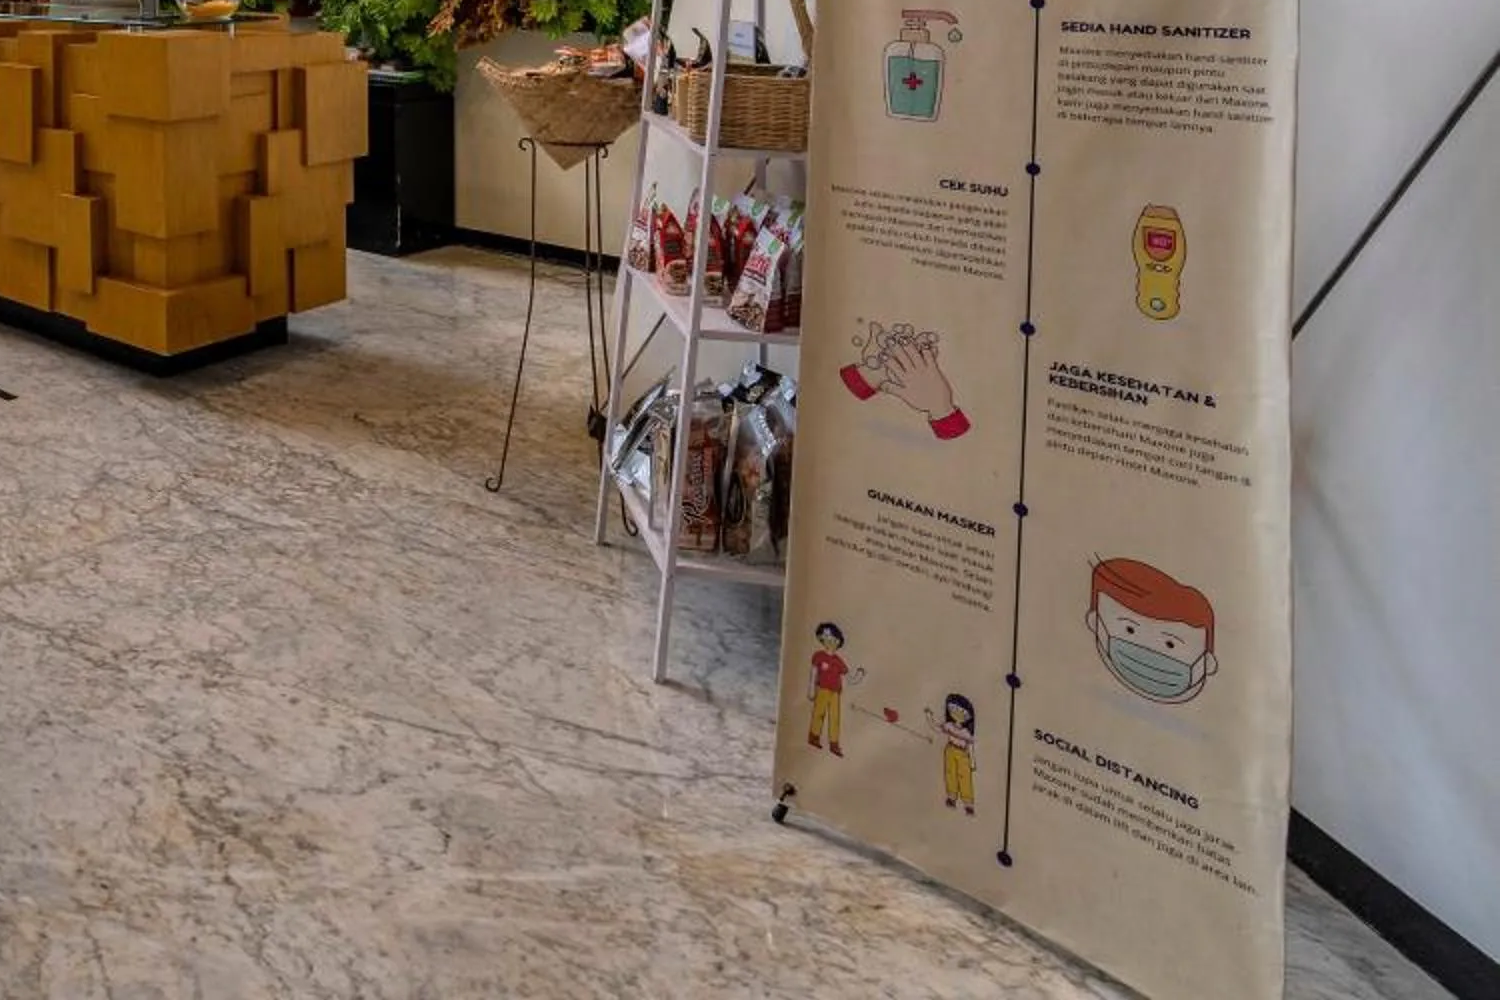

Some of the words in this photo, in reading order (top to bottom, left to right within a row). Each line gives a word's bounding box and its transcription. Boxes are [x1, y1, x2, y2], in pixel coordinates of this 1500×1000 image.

[1061, 21, 1105, 34] SEDIA
[1109, 23, 1157, 36] HAND
[1161, 25, 1252, 40] SANITIZER
[939, 179, 967, 192] CEK
[969, 183, 1009, 197] SUHU
[1049, 361, 1092, 379] JAGA
[1097, 371, 1199, 404] KESEHATAN
[1203, 395, 1217, 409] &
[1049, 373, 1148, 407] KEBERSIHAN
[867, 488, 935, 518] GUNAKAN
[937, 511, 996, 538] MASKER
[1033, 728, 1092, 763] SOCIAL
[1095, 754, 1200, 810] DISTANCING
